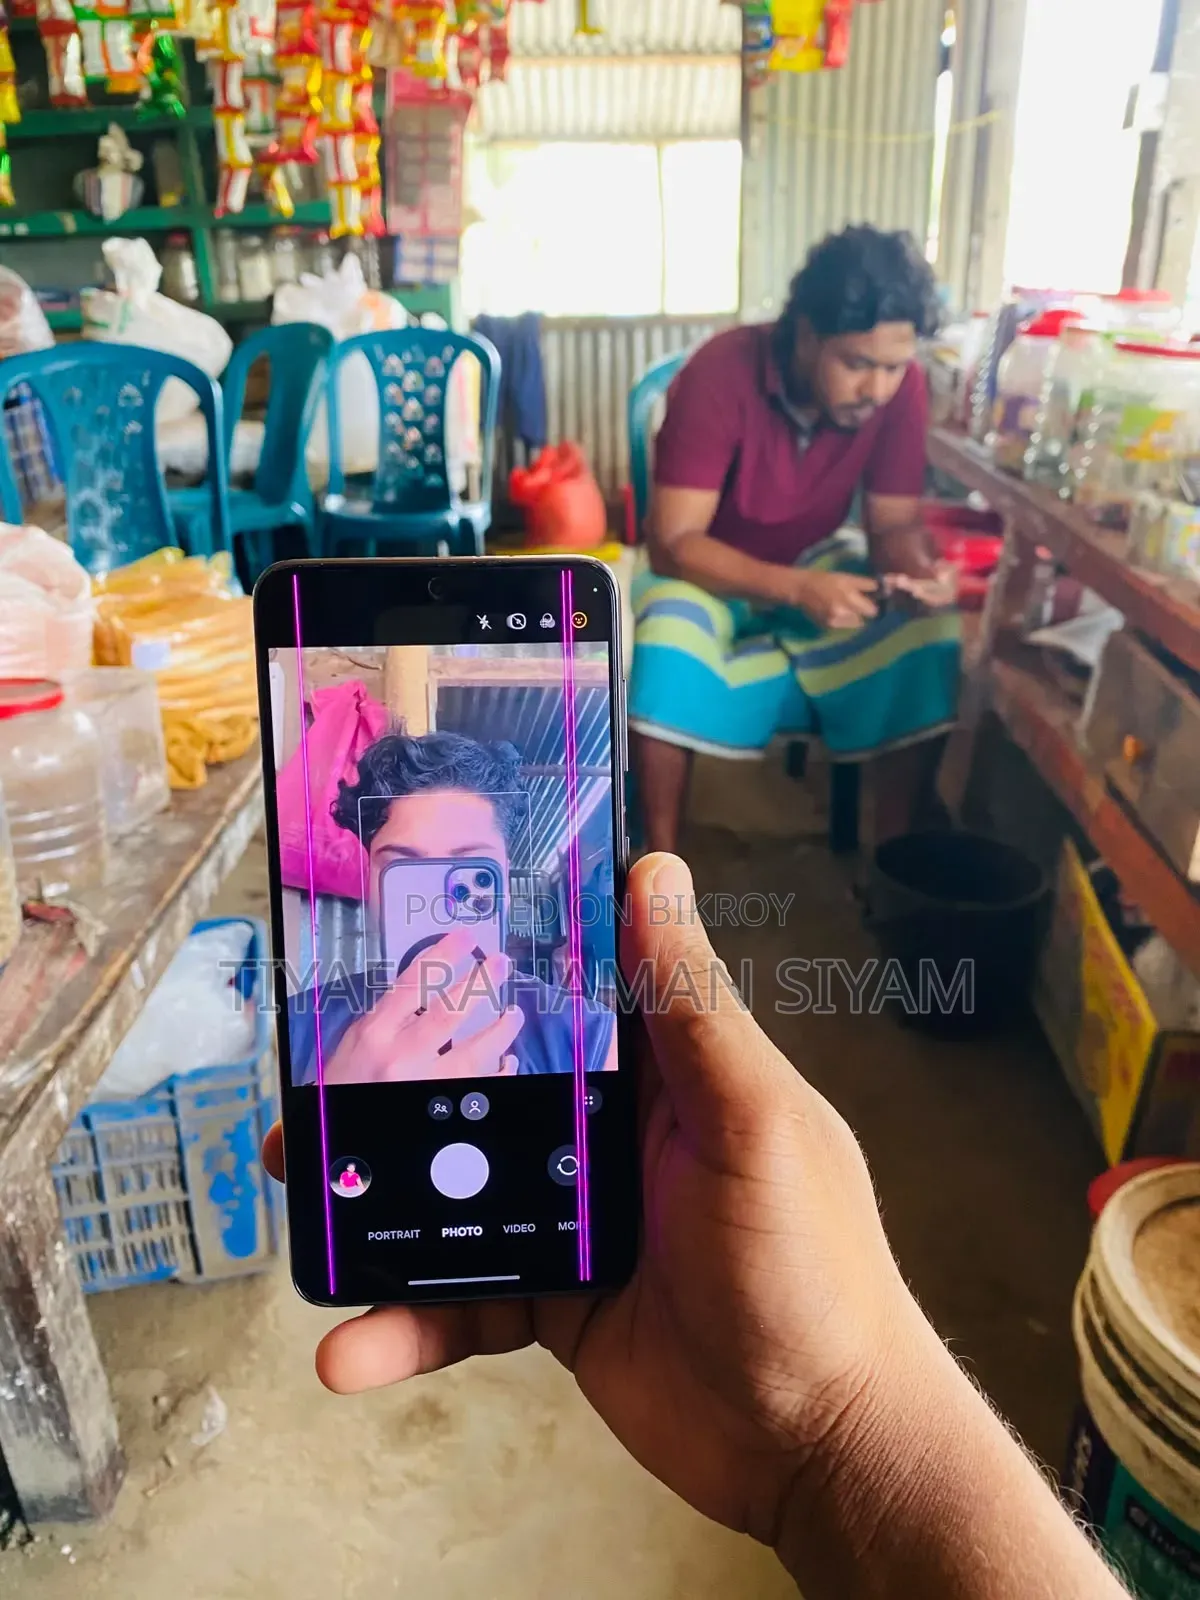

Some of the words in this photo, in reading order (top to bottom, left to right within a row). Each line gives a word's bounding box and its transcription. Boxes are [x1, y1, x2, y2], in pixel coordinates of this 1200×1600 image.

[367, 1229, 421, 1241] PORTRAIT
[441, 1225, 483, 1238] PHOTO
[502, 1223, 536, 1234] VIDEO
